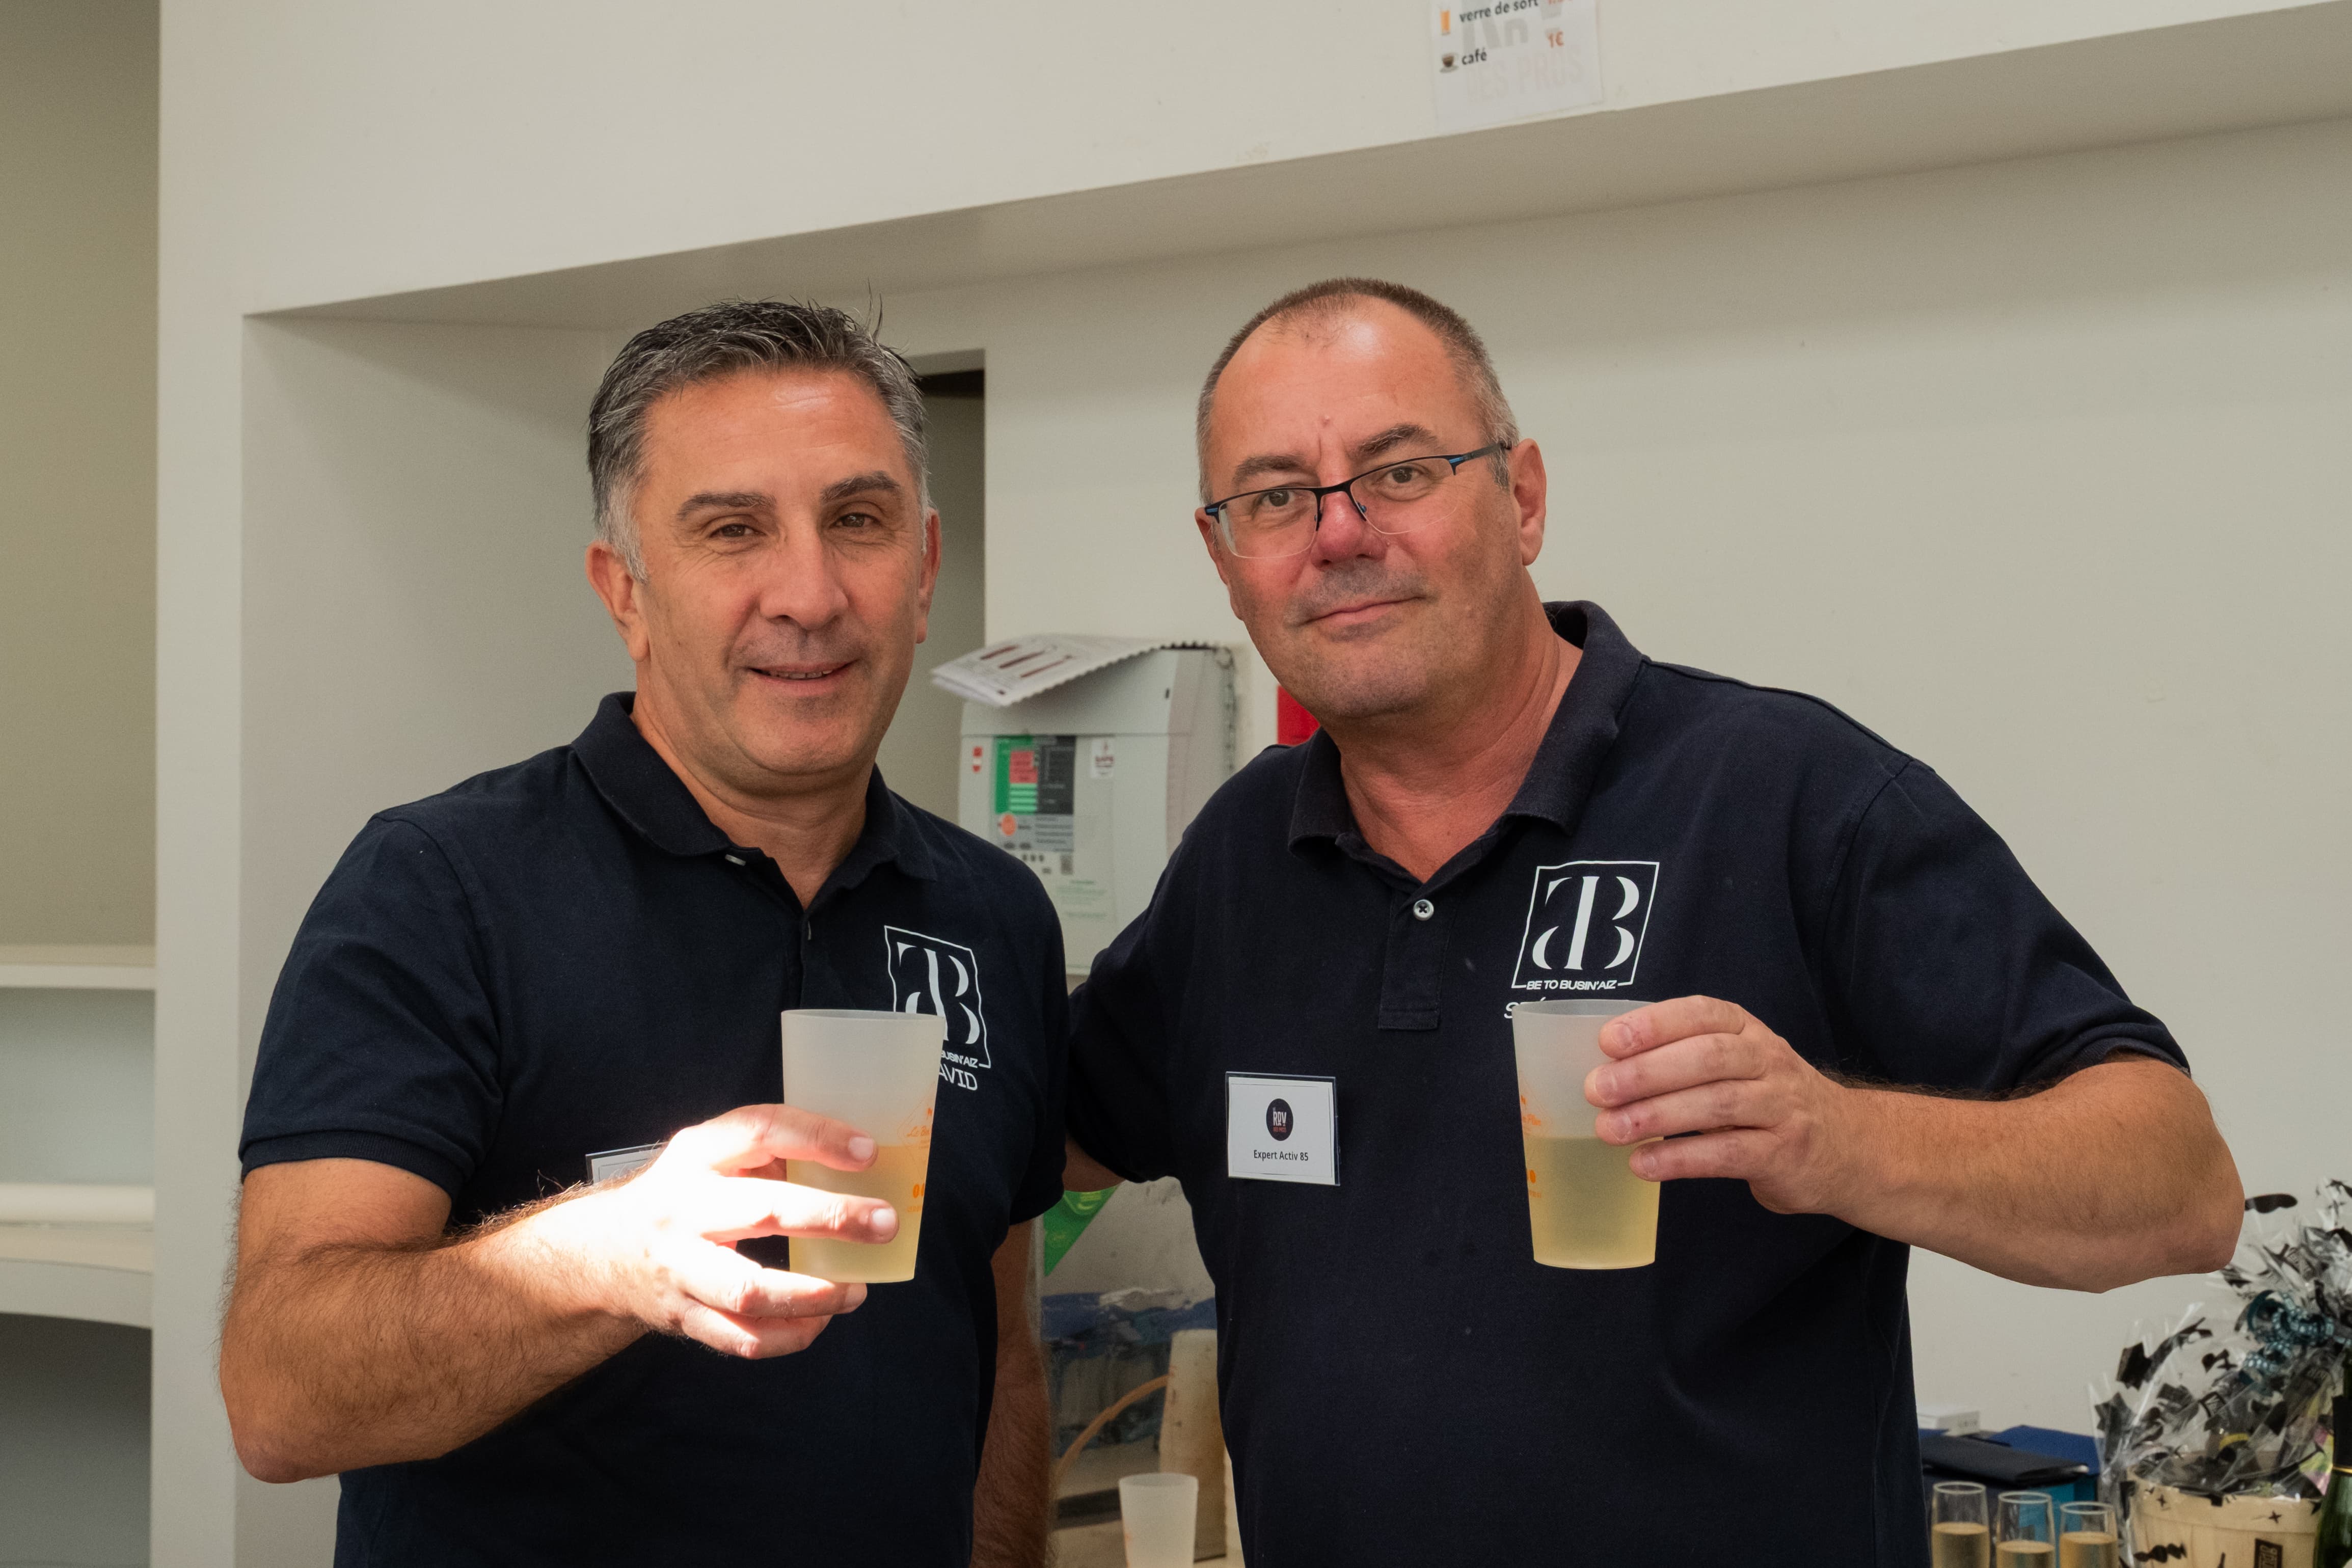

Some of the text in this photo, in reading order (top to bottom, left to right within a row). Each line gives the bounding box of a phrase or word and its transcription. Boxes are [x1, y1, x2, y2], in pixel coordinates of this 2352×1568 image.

[1459, 8, 1491, 22] verre
[1495, 1, 1510, 15] de
[1462, 47, 1487, 65] café
[1526, 981, 1542, 990] BE
[1544, 980, 1558, 990] TO
[939, 1063, 978, 1091] AVID
[1254, 1150, 1309, 1161] Expert Activ 85
